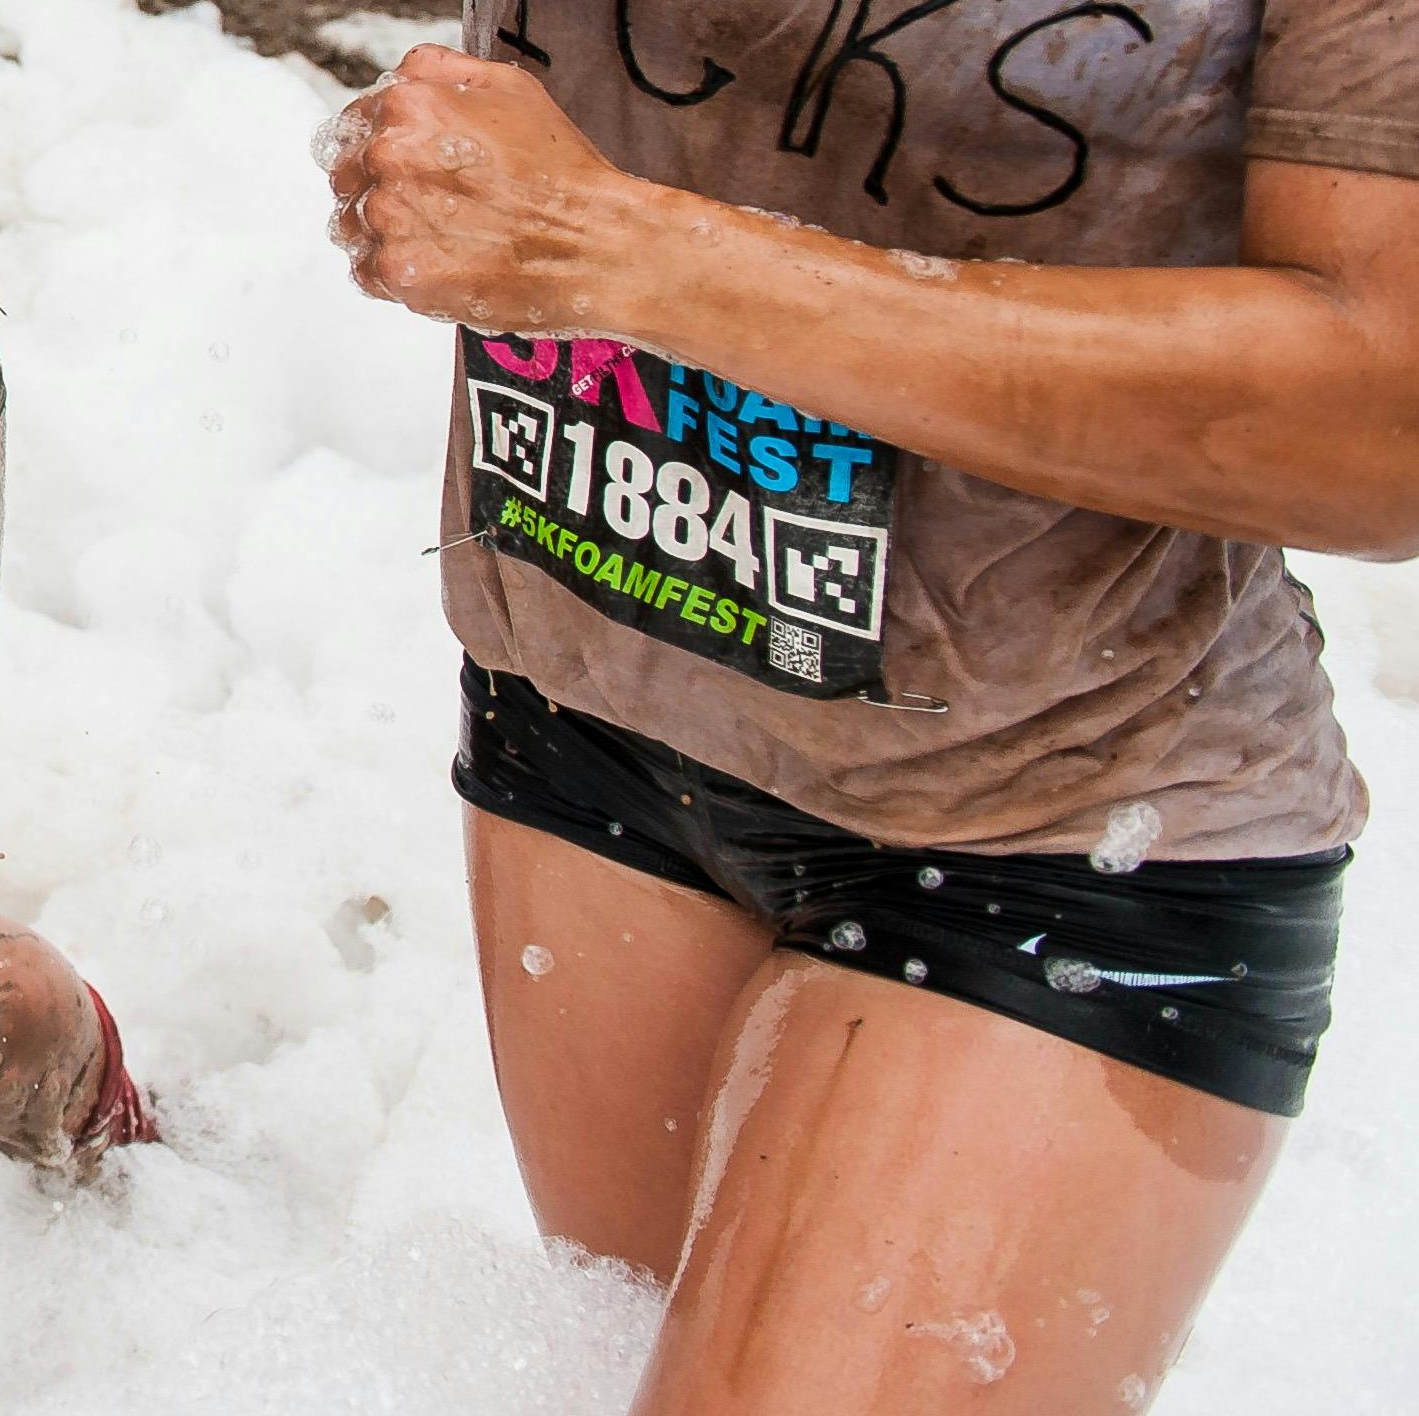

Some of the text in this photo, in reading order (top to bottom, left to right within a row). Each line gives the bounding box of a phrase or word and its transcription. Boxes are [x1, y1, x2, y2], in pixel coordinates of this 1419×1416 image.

[571, 374, 595, 397] GET
[666, 388, 873, 505] FEST
[499, 496, 767, 646] #5KFOAMFEST
[563, 420, 760, 591] 1884
